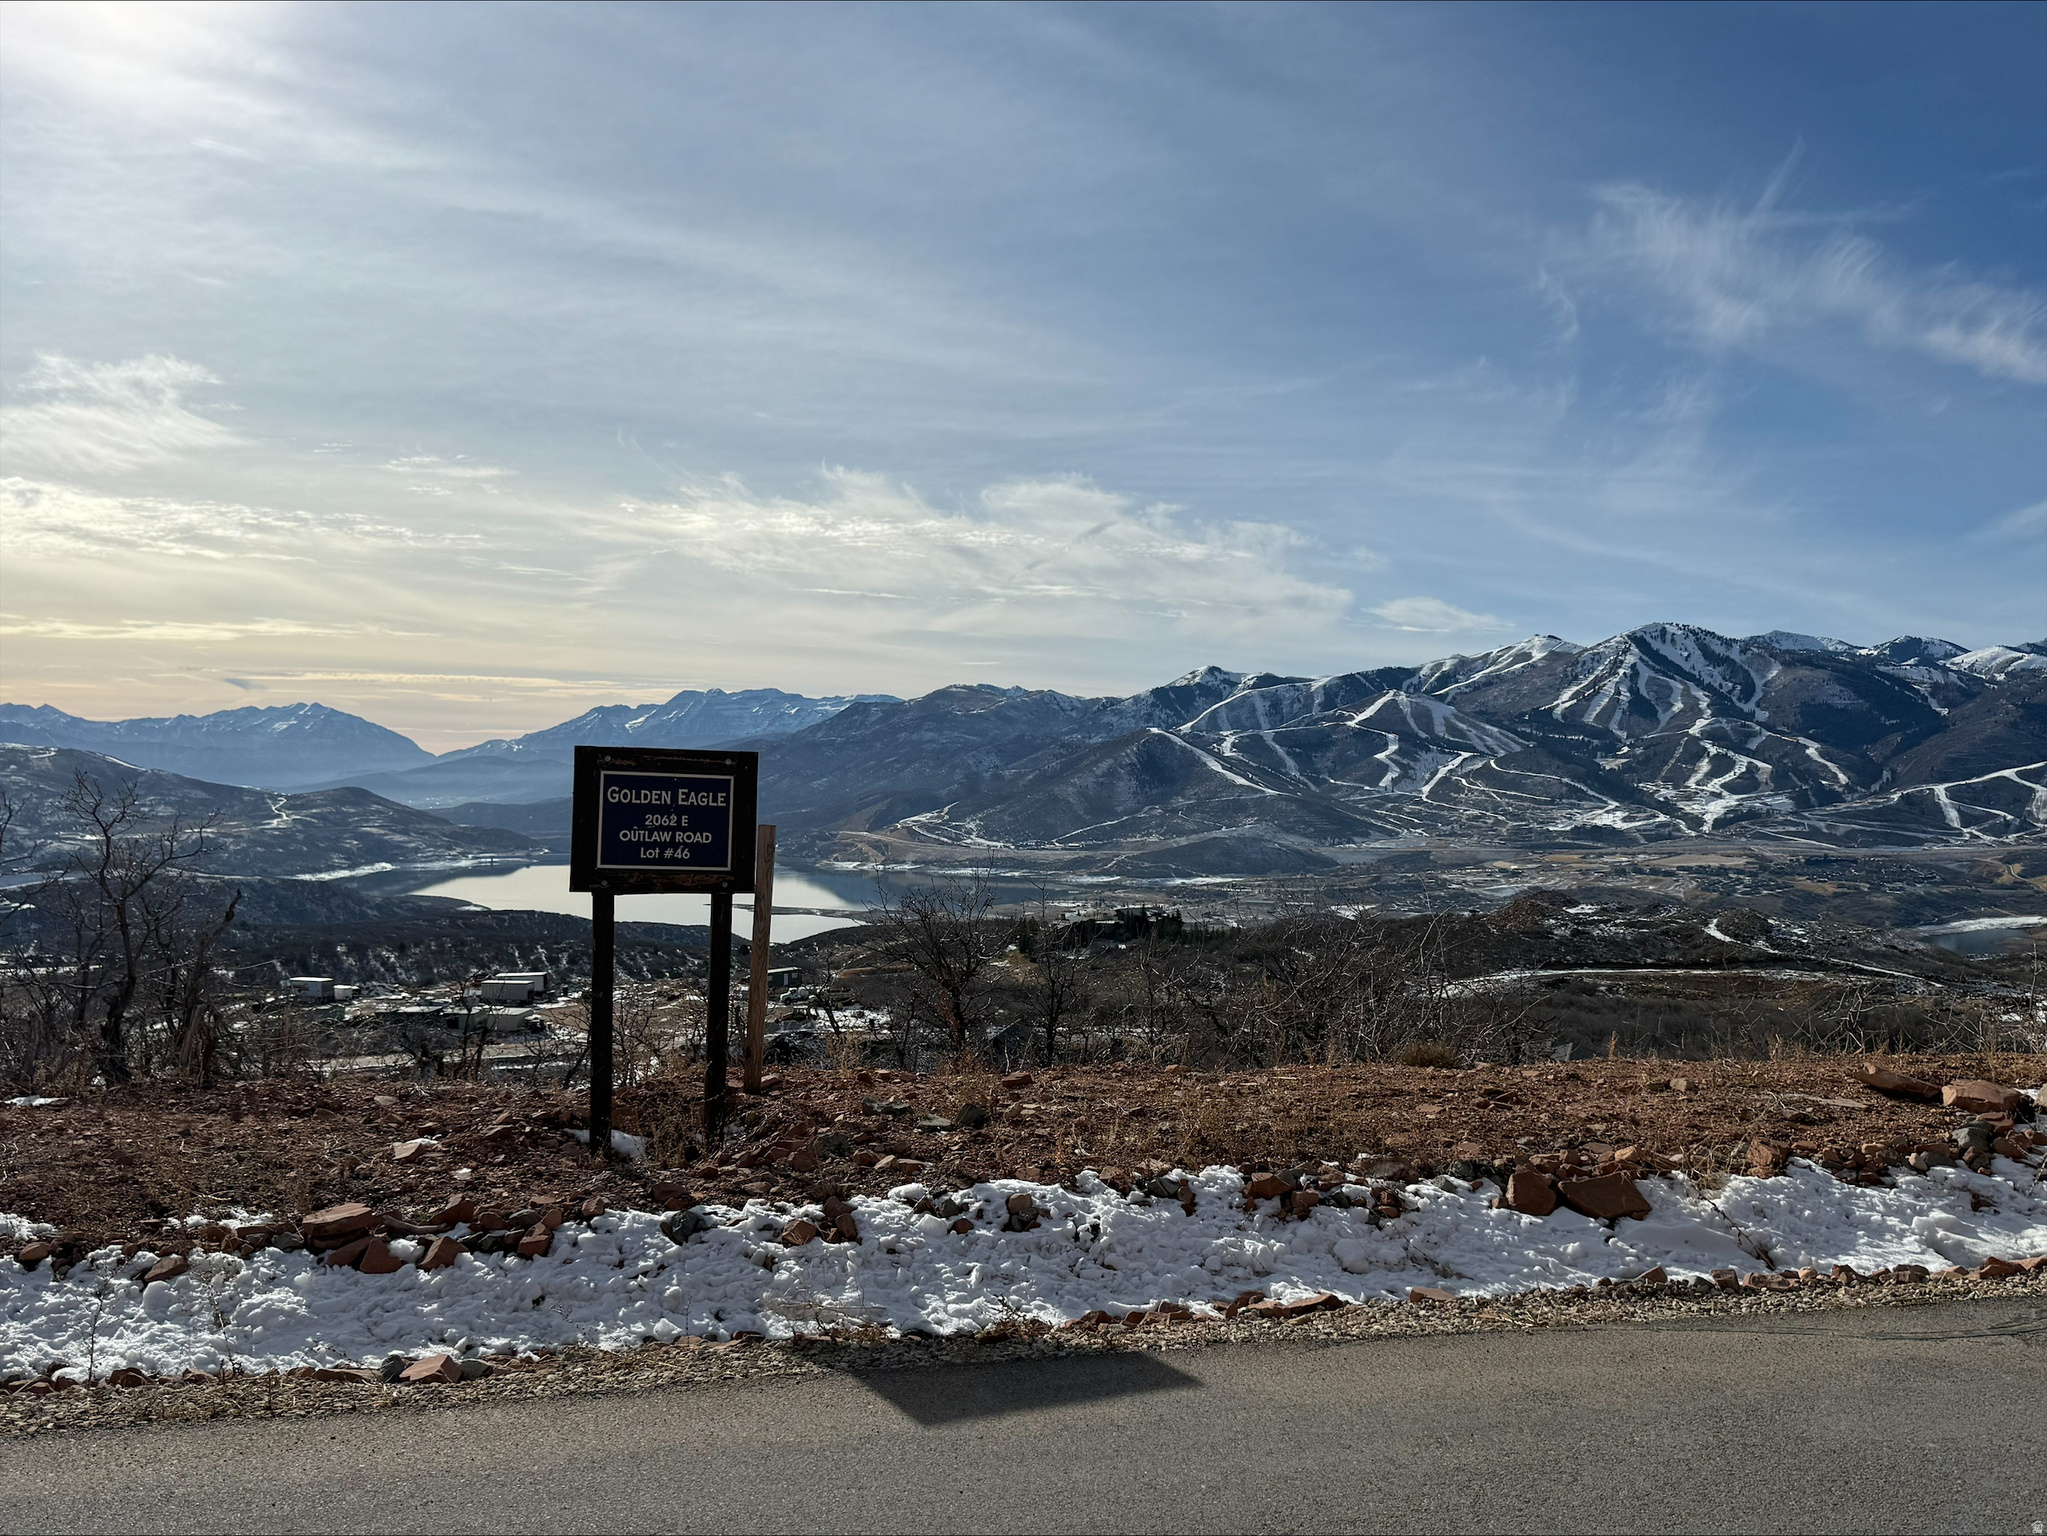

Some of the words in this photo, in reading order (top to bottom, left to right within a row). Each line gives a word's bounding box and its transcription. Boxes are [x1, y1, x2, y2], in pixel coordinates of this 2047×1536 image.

[607, 786, 671, 804] GOLDEN
[678, 788, 727, 806] EAGLE
[645, 814, 677, 826] 2062
[681, 815, 689, 826] E
[619, 830, 672, 842] OUTLAW
[675, 831, 712, 843] ROAD
[640, 847, 660, 858] Lot
[663, 847, 690, 859] #46
